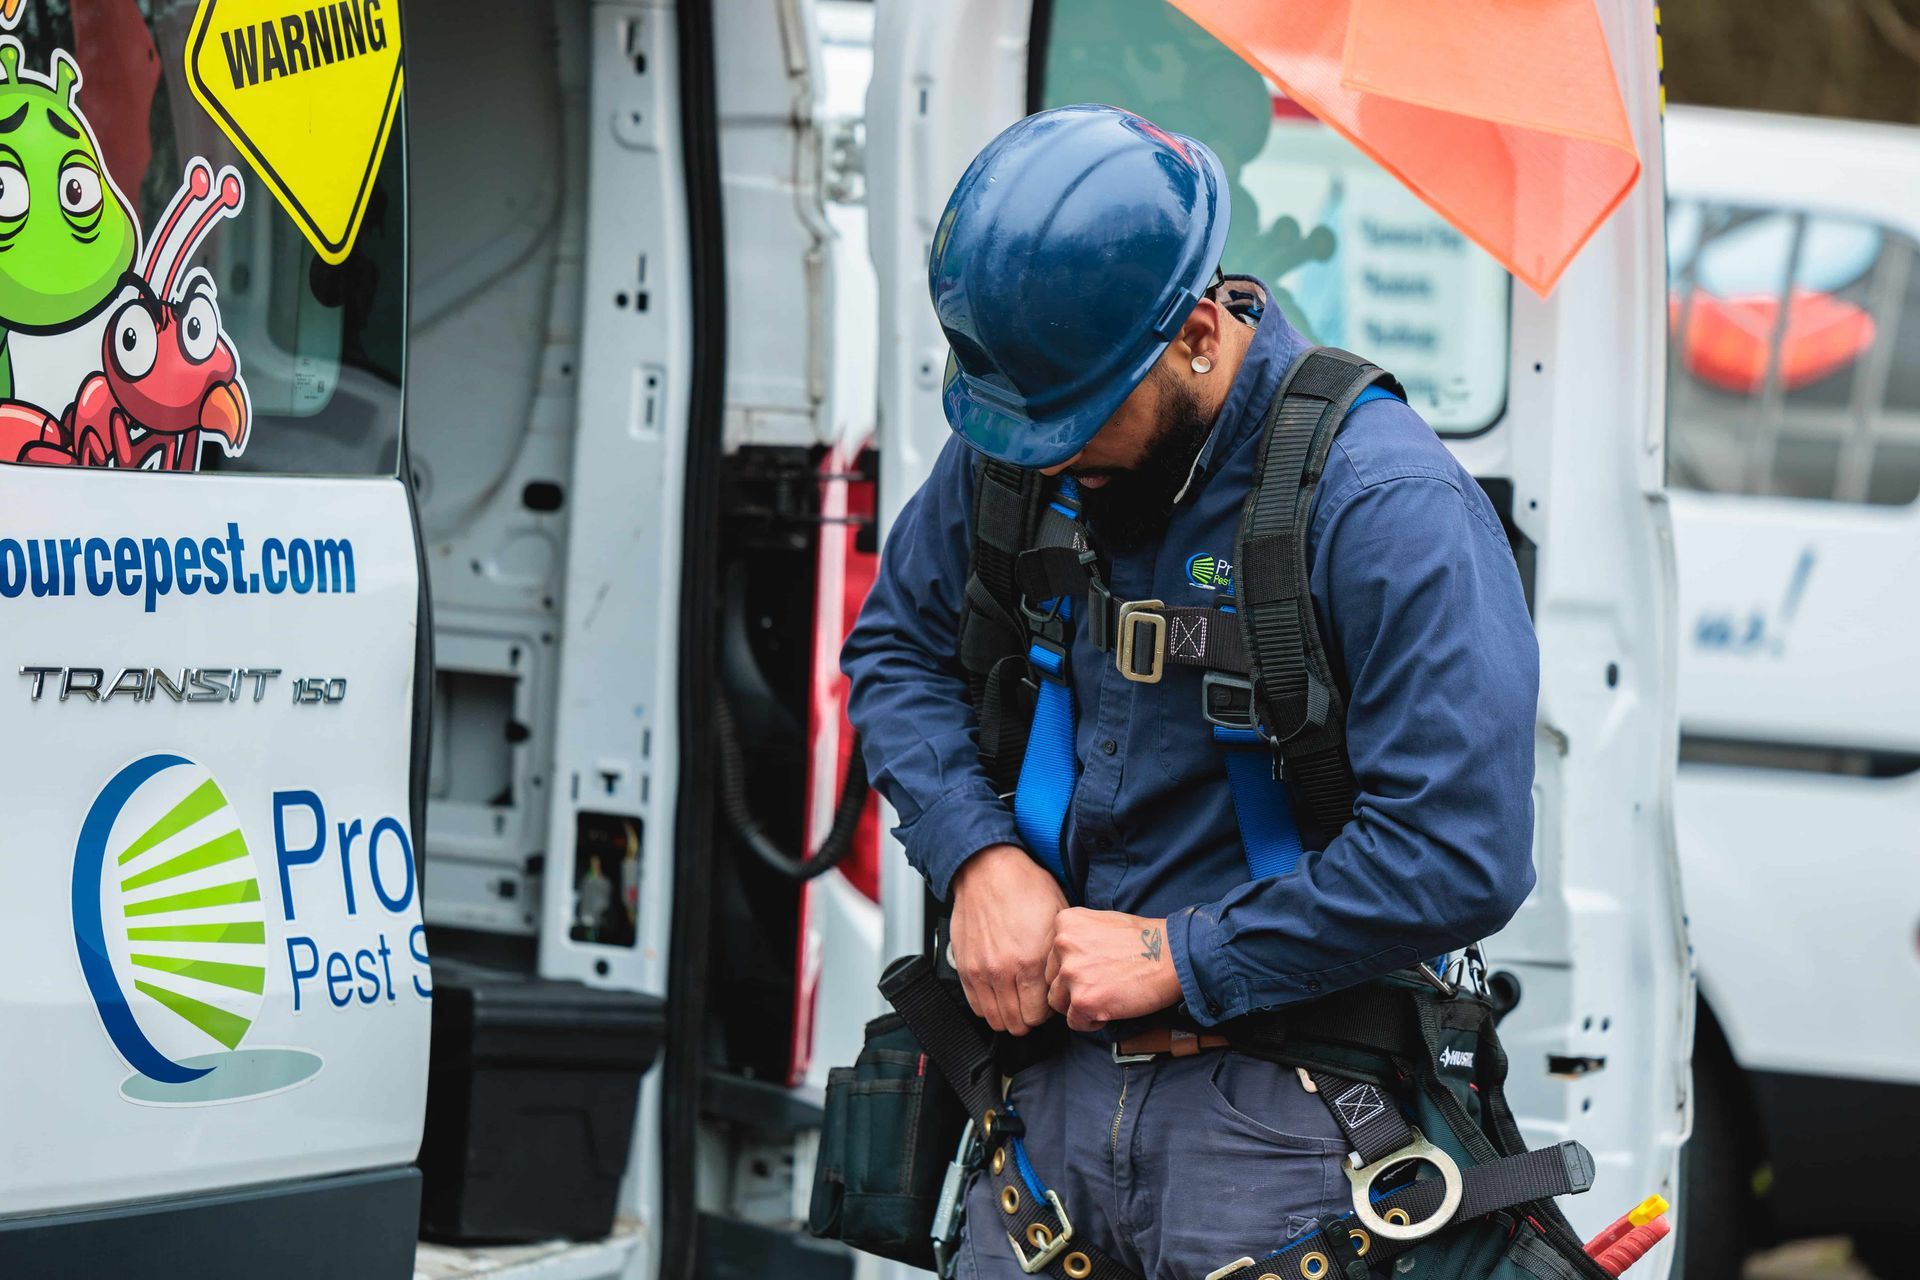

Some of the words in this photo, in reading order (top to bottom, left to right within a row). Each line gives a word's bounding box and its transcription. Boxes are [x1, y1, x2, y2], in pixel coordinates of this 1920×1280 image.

[220, 0, 387, 90] WARNING
[0, 522, 356, 612] ourcepest.com
[19, 666, 282, 701] TRANSIT
[292, 678, 347, 704] 150
[273, 790, 415, 921] Pro
[286, 934, 396, 1011] Pest
